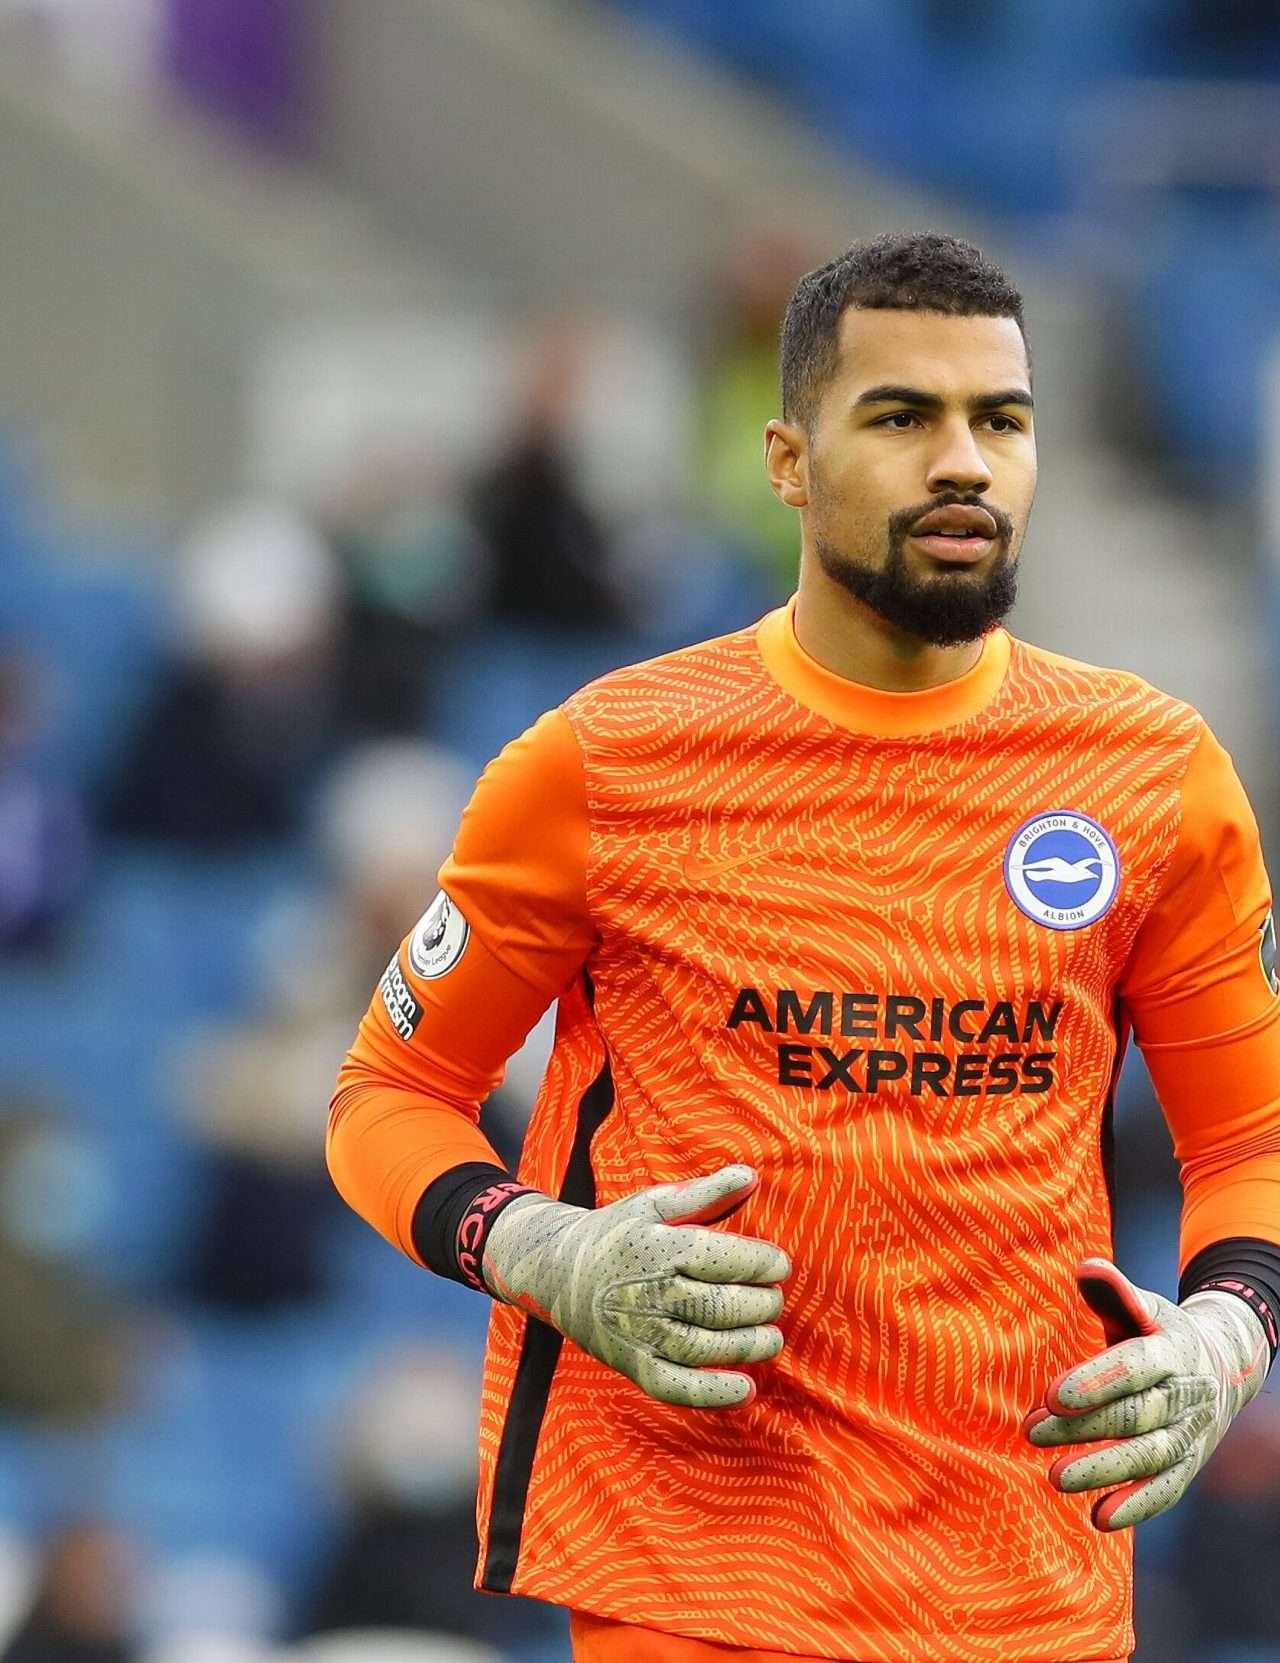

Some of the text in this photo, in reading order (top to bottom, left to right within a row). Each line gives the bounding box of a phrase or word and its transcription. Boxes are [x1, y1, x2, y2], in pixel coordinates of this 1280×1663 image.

[1019, 818, 1106, 849] BRIGHTON & HOVE
[1042, 909, 1085, 921] ALBION
[726, 988, 1063, 1044] AMERICAN
[778, 1043, 1056, 1097] EXPRESS
